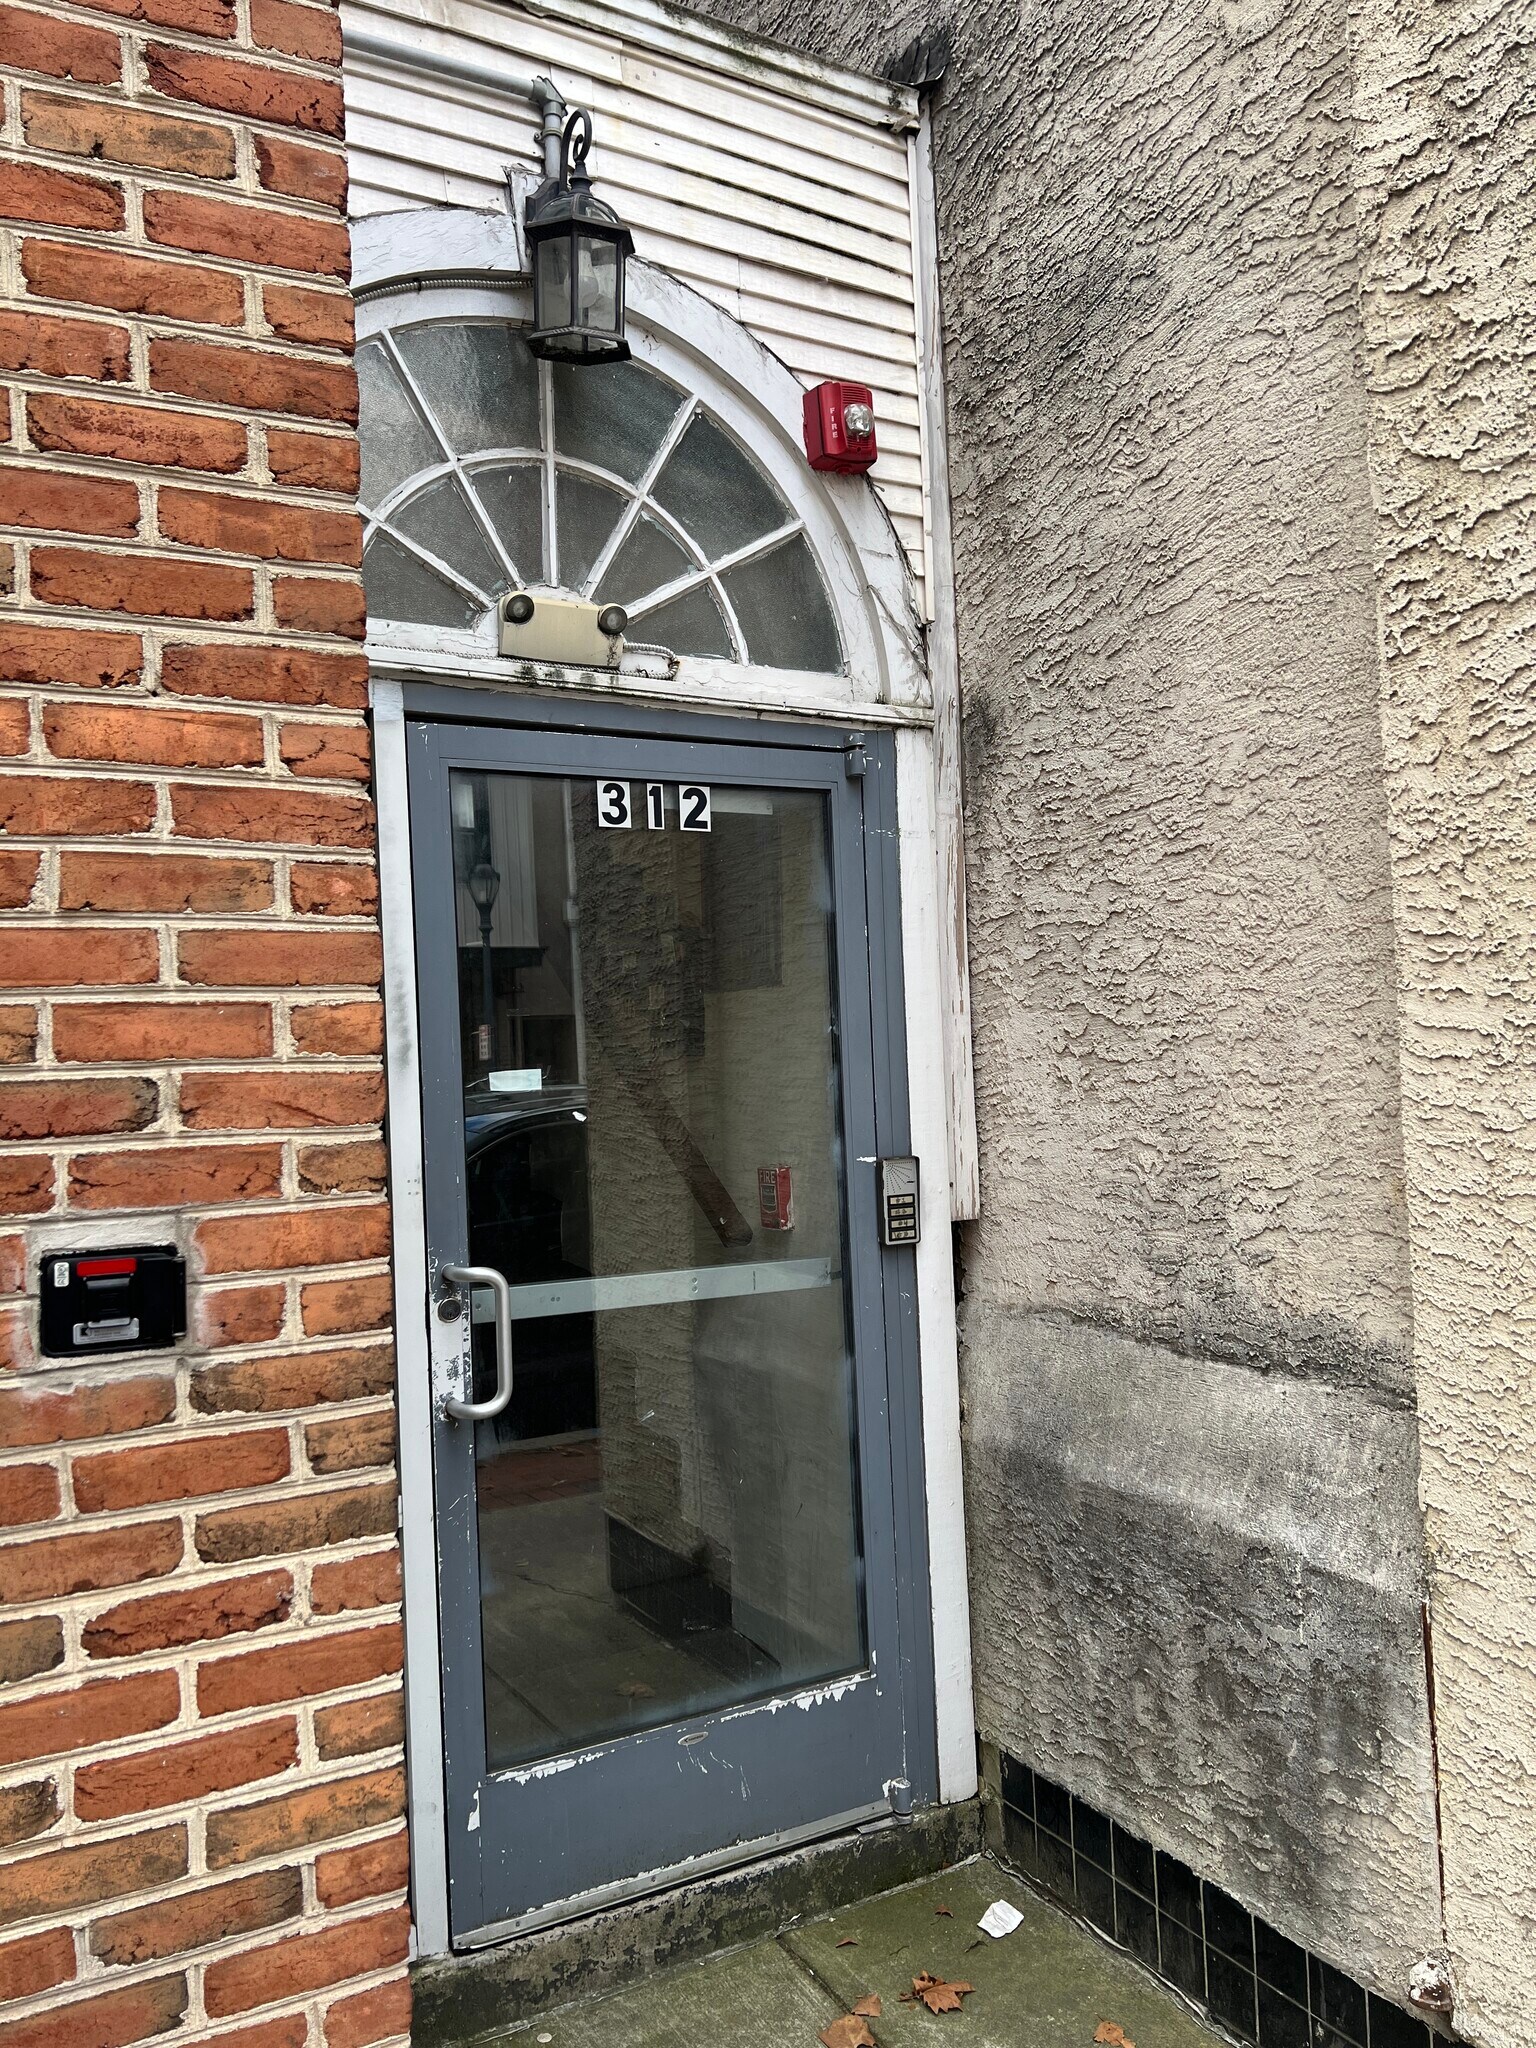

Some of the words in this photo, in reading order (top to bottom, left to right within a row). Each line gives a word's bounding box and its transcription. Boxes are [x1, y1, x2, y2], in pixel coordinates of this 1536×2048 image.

[830, 407, 838, 438] FIRE
[601, 782, 708, 829] 312
[760, 1170, 776, 1183] FIRE
